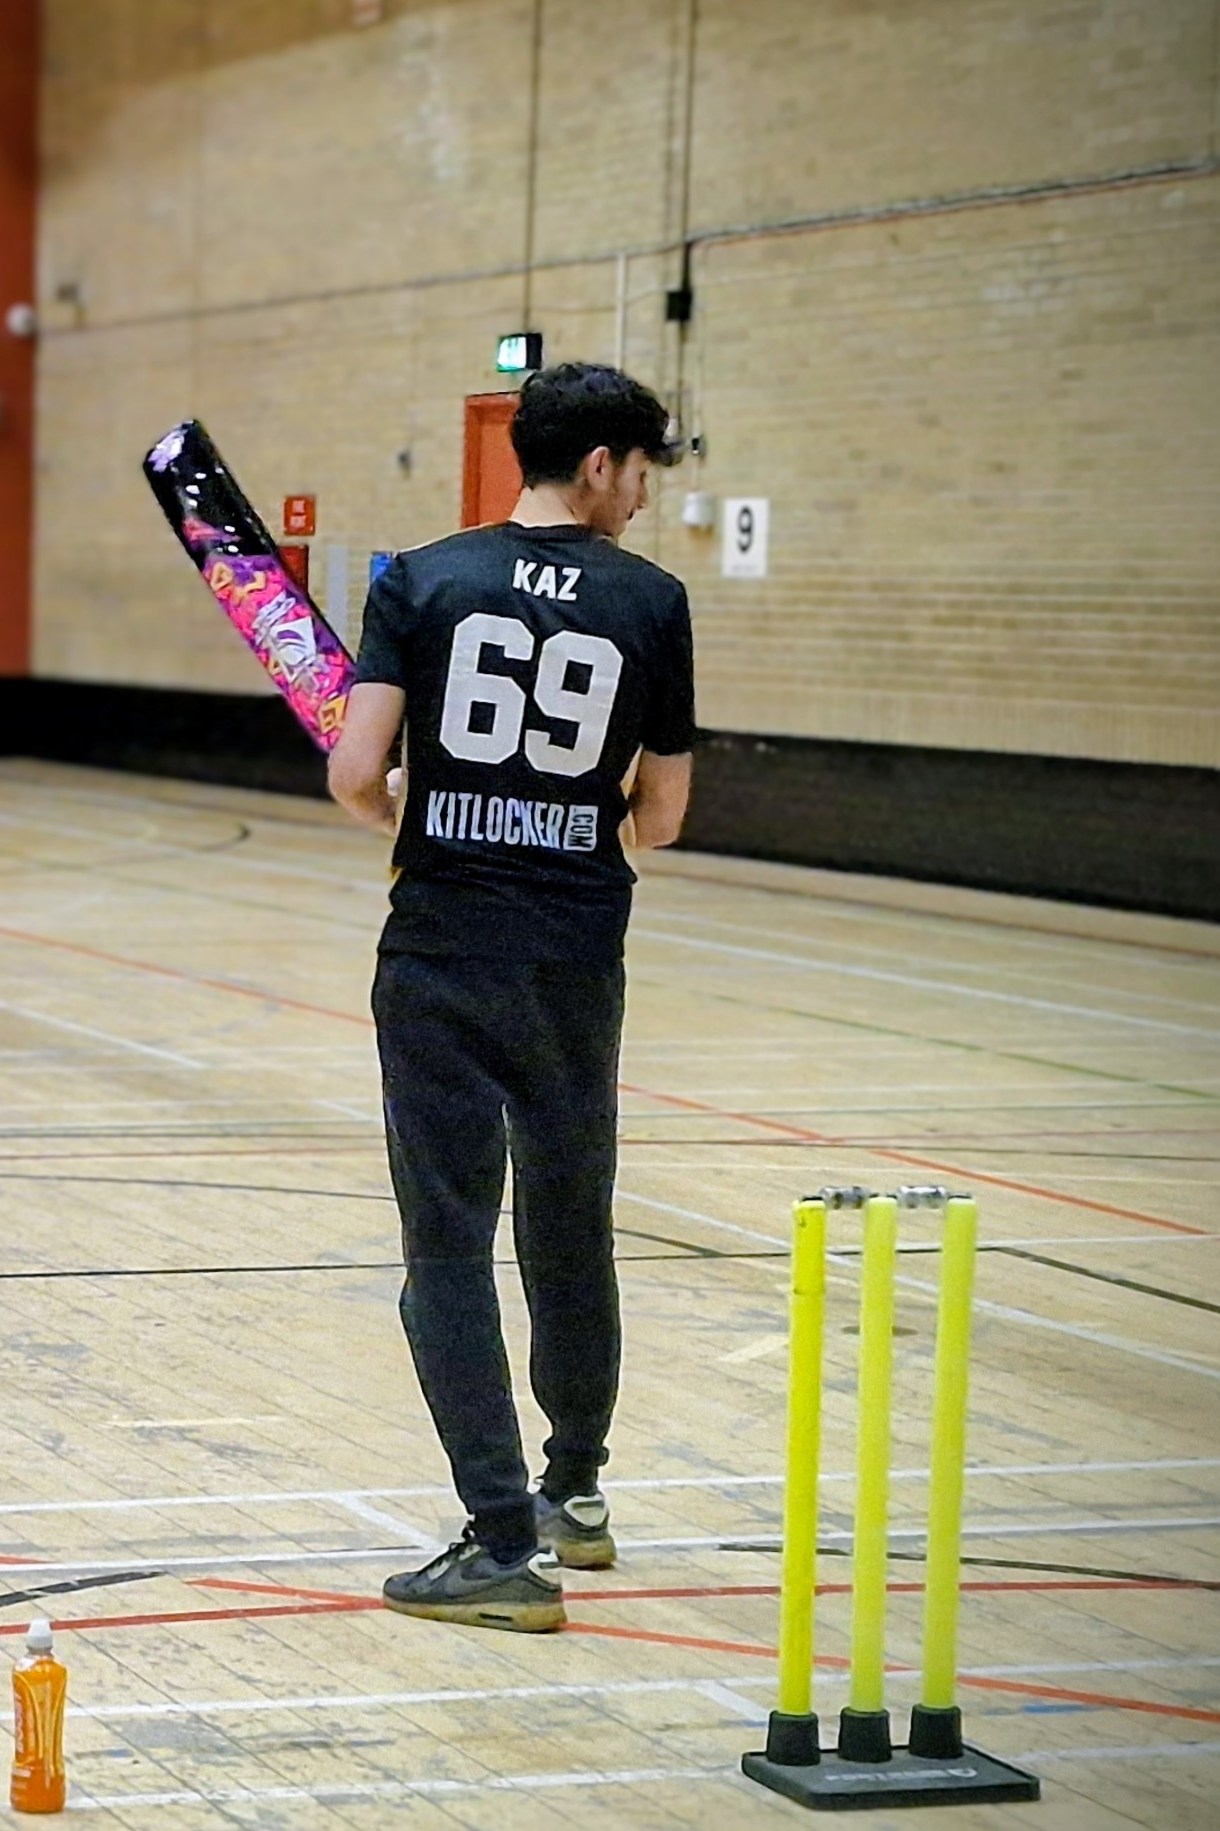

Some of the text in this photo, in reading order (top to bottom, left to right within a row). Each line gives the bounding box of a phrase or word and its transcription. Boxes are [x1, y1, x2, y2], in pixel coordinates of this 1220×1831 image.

[736, 505, 754, 555] 9
[512, 558, 582, 601] KAZ
[439, 612, 624, 778] 69
[426, 790, 565, 849] KITLOCKER
